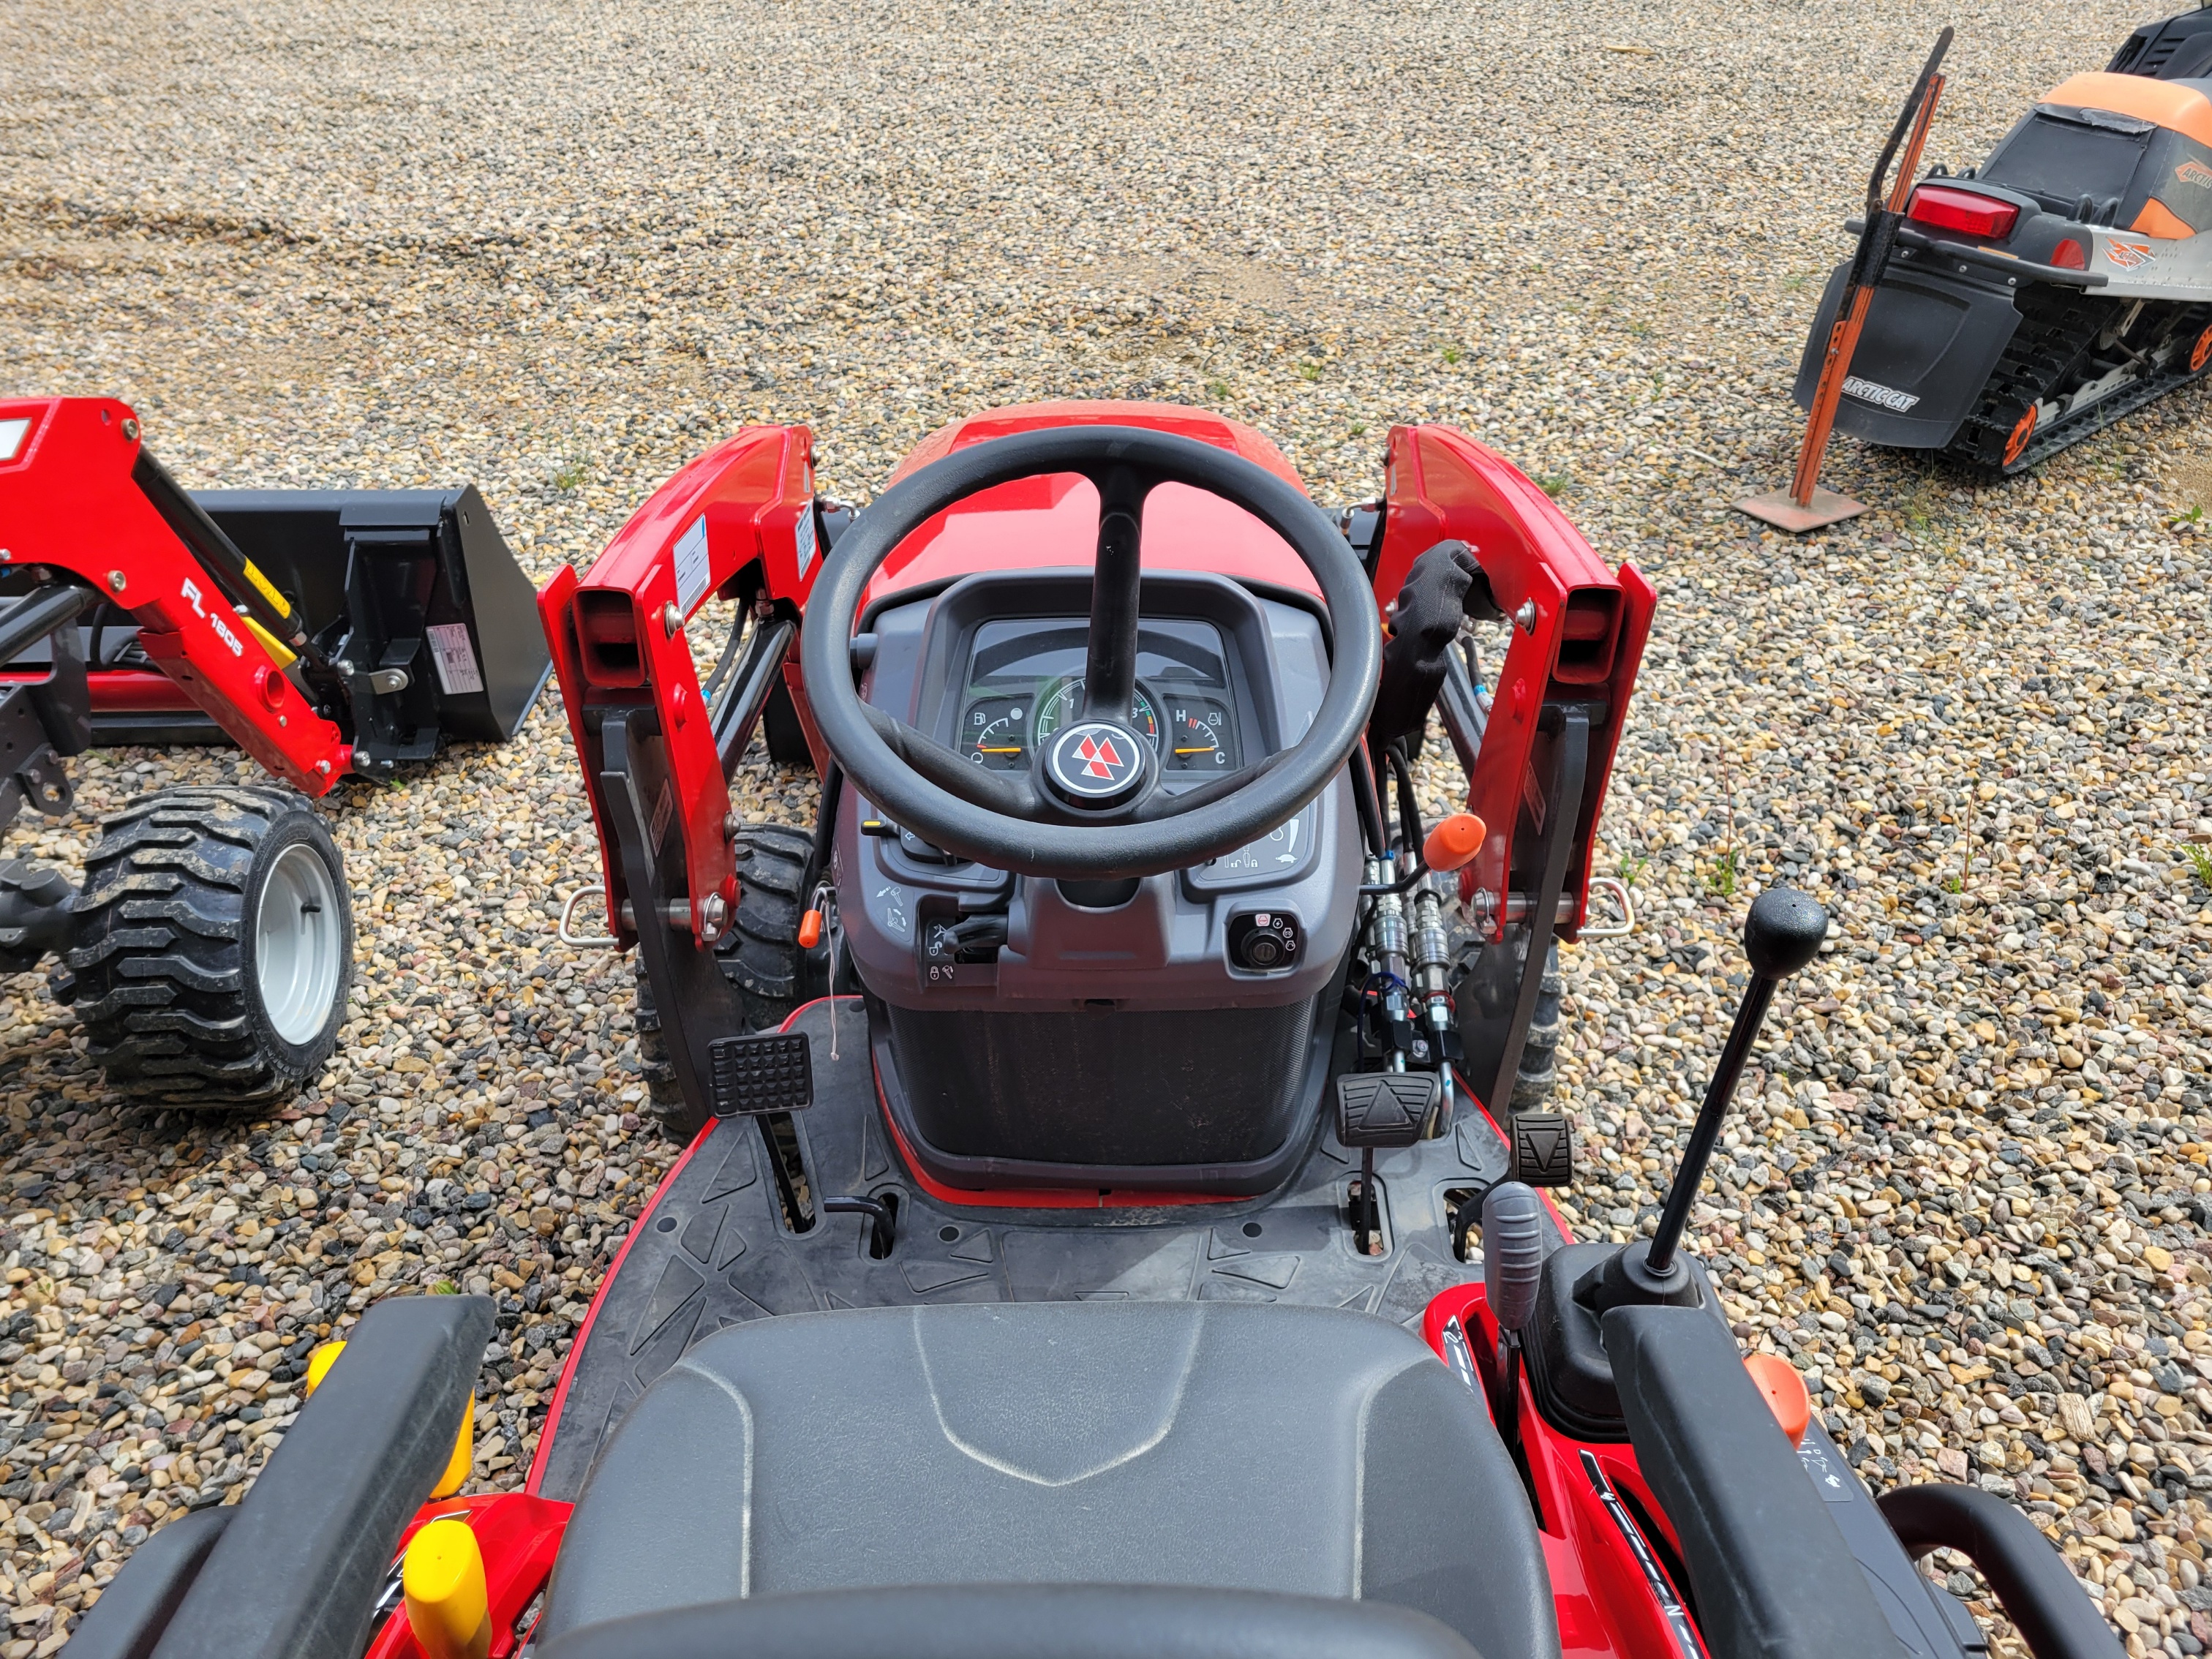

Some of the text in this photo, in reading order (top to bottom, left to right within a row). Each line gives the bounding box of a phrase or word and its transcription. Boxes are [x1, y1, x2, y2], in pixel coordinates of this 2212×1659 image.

[1842, 378, 1916, 410] ARCTIC CAT
[181, 577, 244, 657] FL 1805
[1069, 698, 1075, 709] 1
[1132, 707, 1138, 718] 3
[1176, 710, 1186, 722] H
[1215, 752, 1225, 764] C
